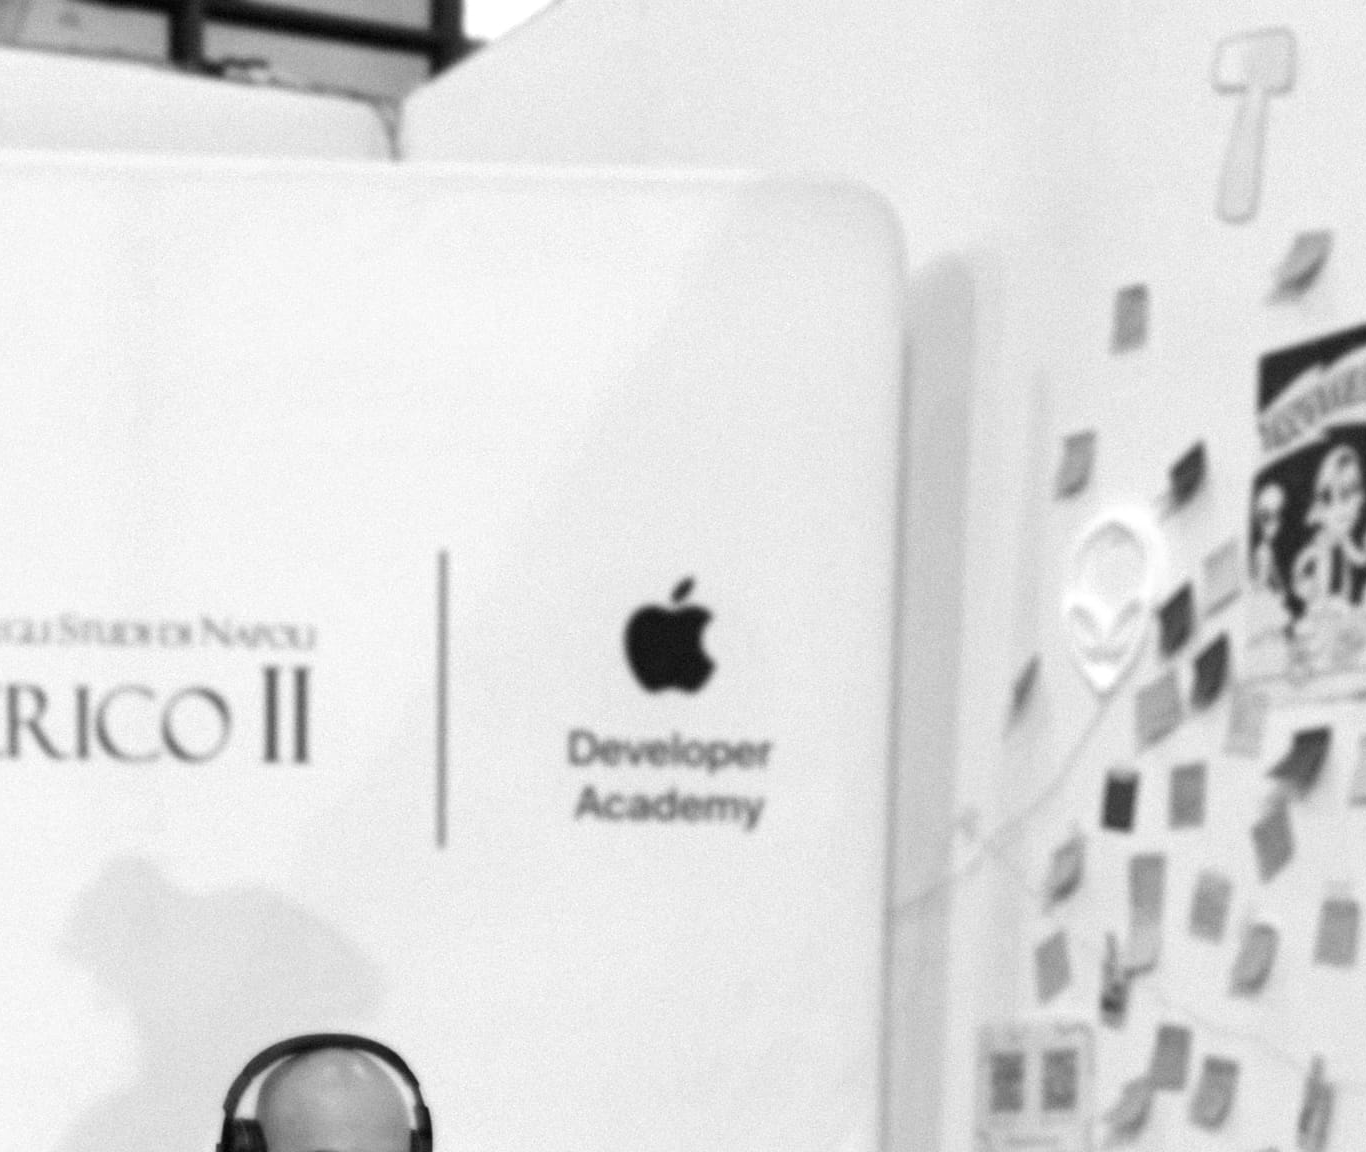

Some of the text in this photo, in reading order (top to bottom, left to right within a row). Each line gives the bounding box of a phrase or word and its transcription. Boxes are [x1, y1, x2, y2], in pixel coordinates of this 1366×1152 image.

[259, 664, 312, 764] II
[567, 730, 772, 774] Developer
[575, 785, 764, 833] Academy
